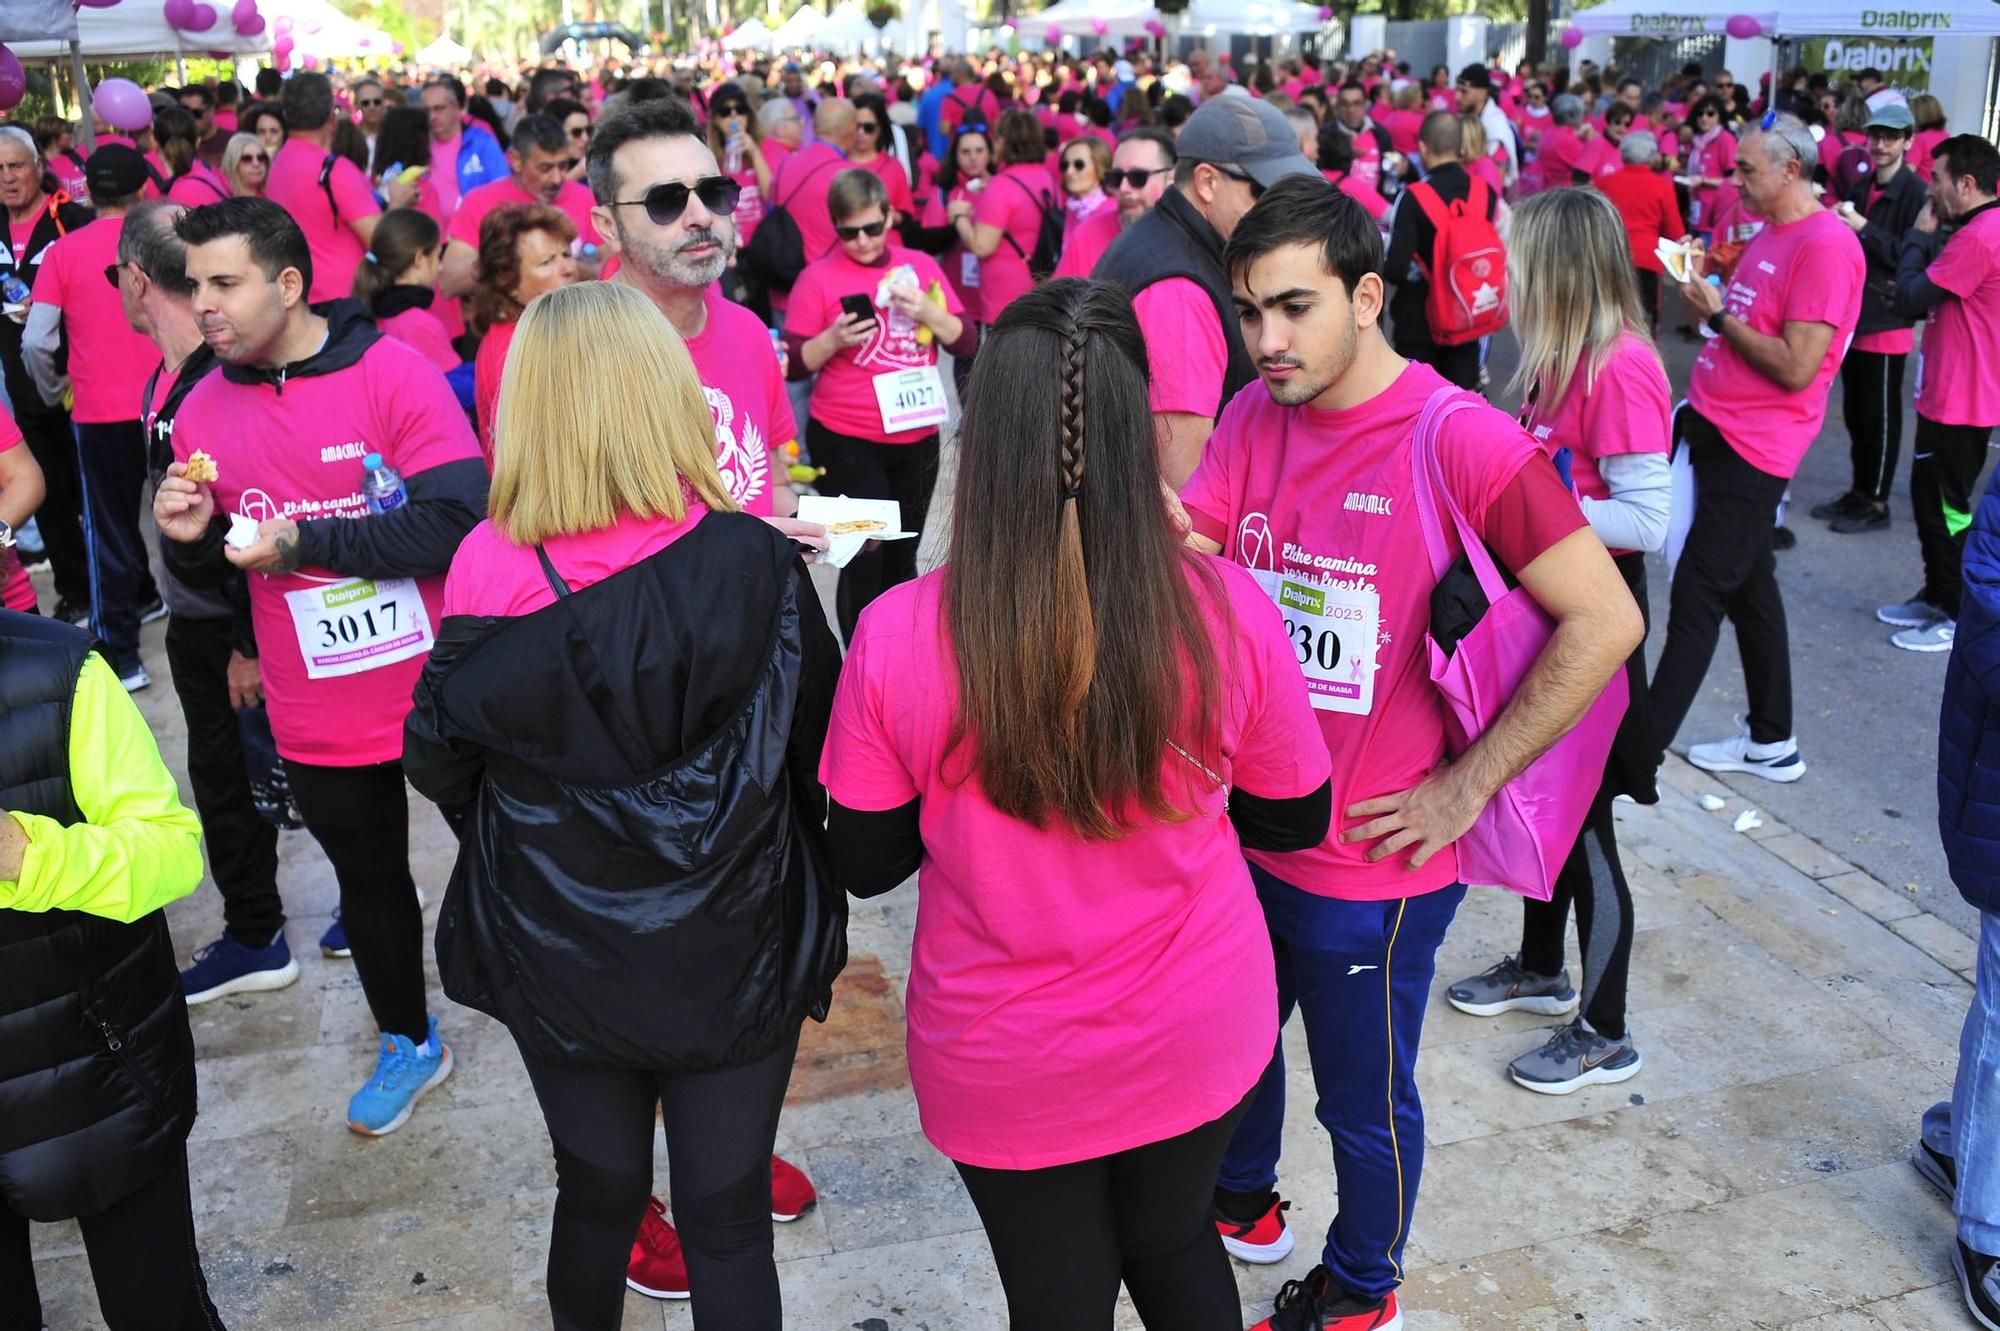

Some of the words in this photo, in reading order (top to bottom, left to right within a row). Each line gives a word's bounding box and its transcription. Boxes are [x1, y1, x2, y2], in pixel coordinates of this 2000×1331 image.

[1631, 14, 1707, 33] Dialprix
[1862, 10, 1951, 31] Dialprix
[1823, 41, 1931, 72] Dialprix
[895, 386, 934, 410] 4027
[282, 498, 321, 516] Elche
[322, 491, 366, 510] camin
[1281, 542, 1313, 565] Elche
[1313, 554, 1378, 577] camina
[325, 584, 374, 604] Dialprix
[1319, 571, 1378, 593] fuerte
[1283, 587, 1321, 609] Dialprix
[1325, 605, 1364, 621] 2023
[316, 599, 397, 648] 3017
[1317, 683, 1328, 691] DE
[1329, 685, 1353, 695] MAMA
